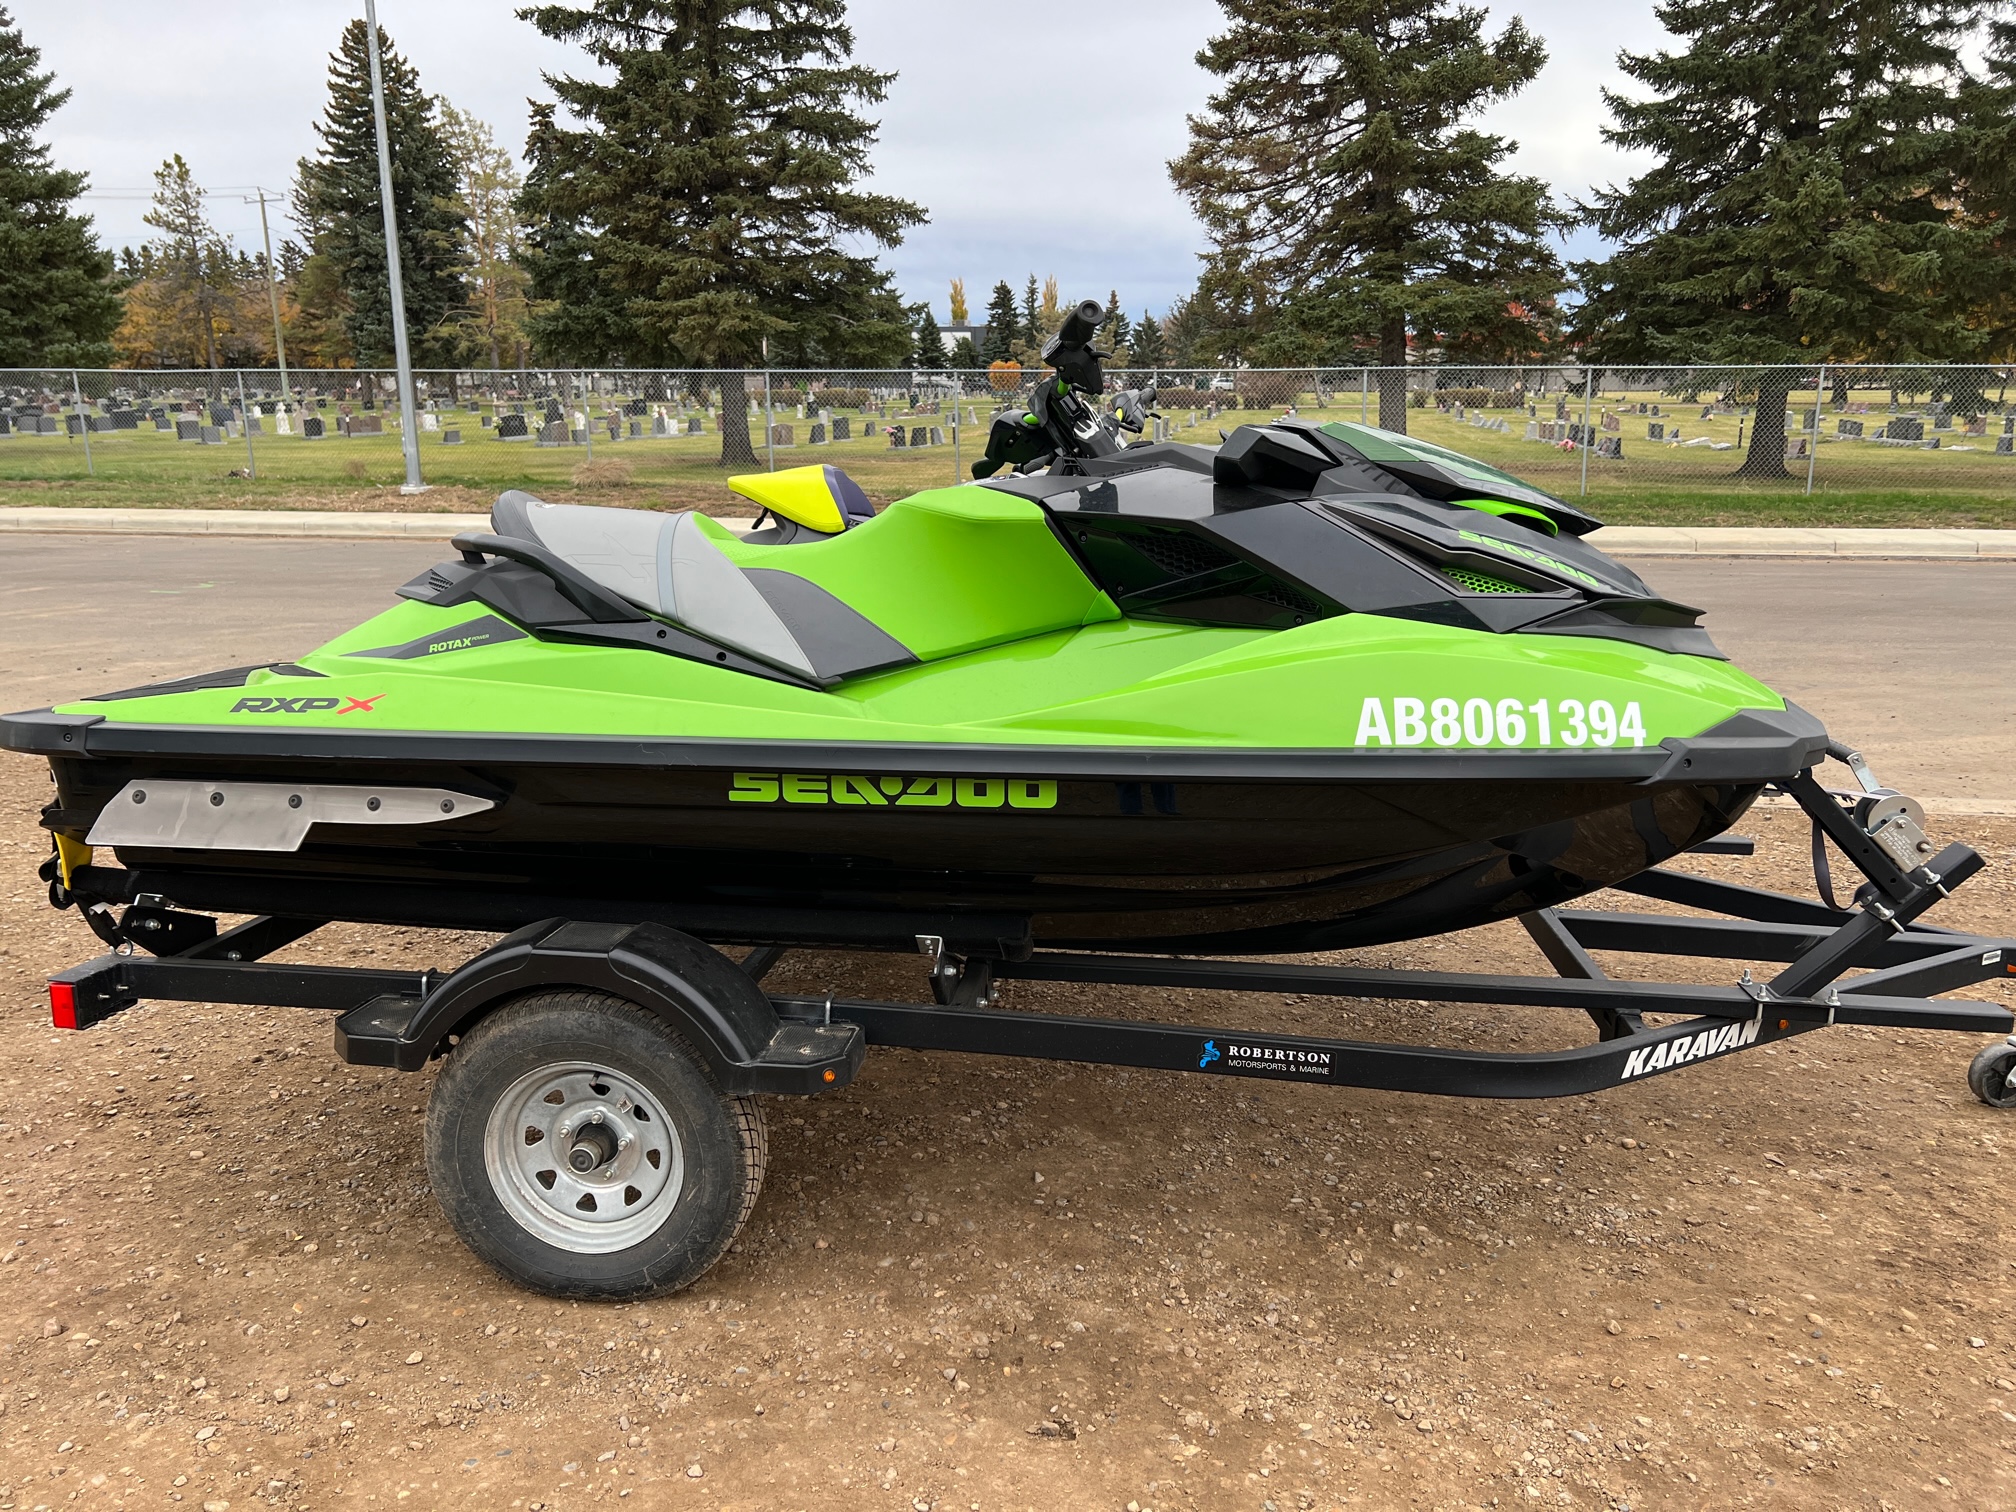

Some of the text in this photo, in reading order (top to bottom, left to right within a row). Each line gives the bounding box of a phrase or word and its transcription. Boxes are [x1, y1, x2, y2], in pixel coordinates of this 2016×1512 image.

[428, 637, 472, 653] ROTAX
[1354, 697, 1647, 747] AB8061394
[1228, 1045, 1331, 1064] ROBERTSON
[1621, 1019, 1762, 1079] KARAVAN
[1228, 1059, 1330, 1075] MOTORSPORTS & MARINE
